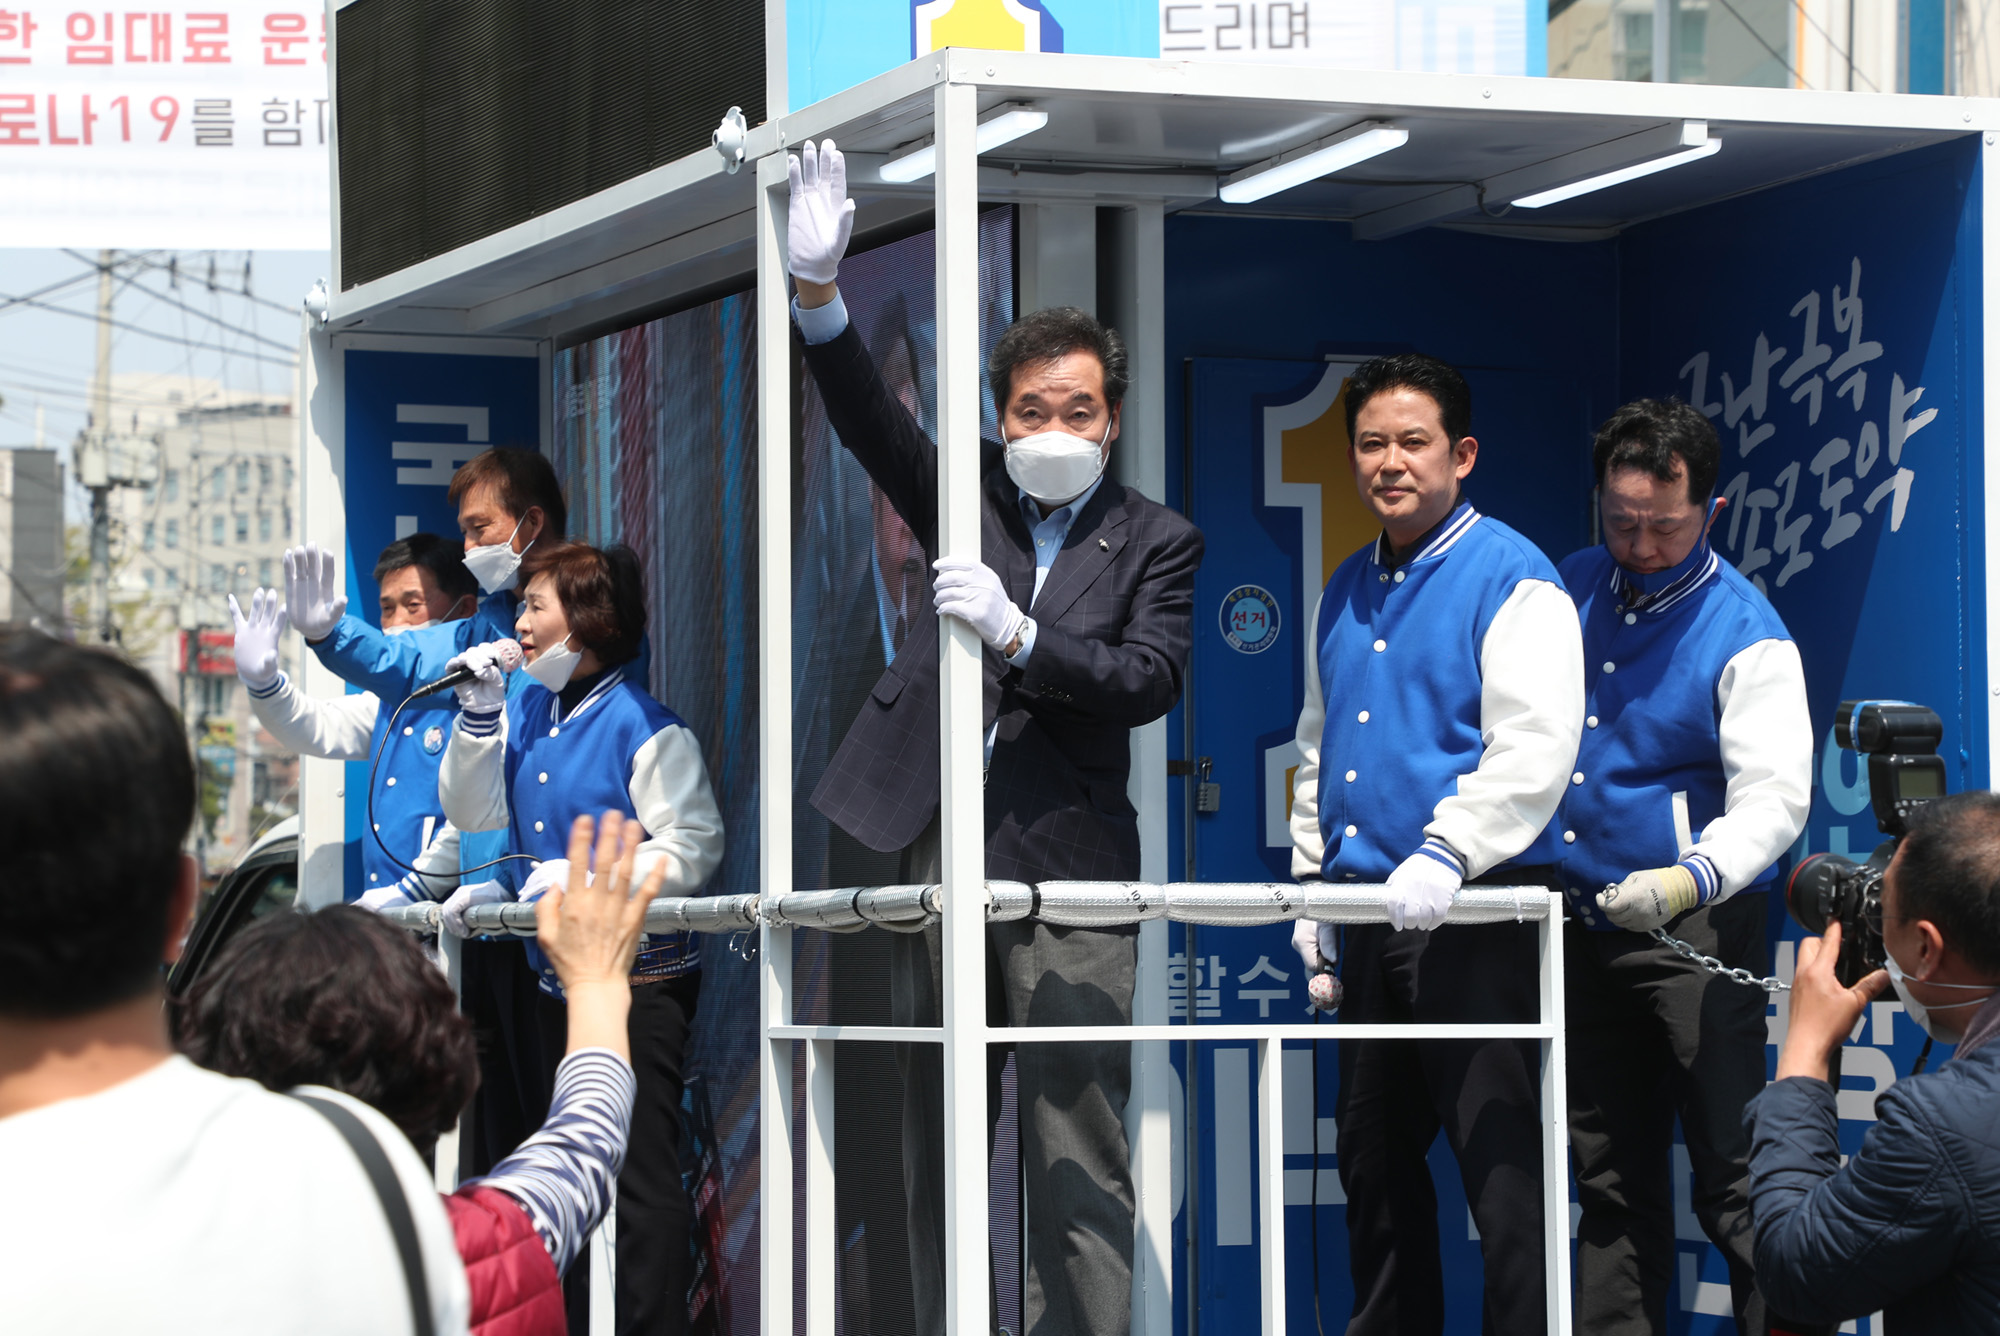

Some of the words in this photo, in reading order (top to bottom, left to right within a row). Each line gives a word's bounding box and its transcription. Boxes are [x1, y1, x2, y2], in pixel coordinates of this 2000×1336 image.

[66, 12, 231, 65] 임대료
[261, 13, 327, 65] 운
[1163, 2, 1309, 51] 드리며
[1231, 610, 1266, 631] 선거
[1237, 955, 1291, 1018] 수
